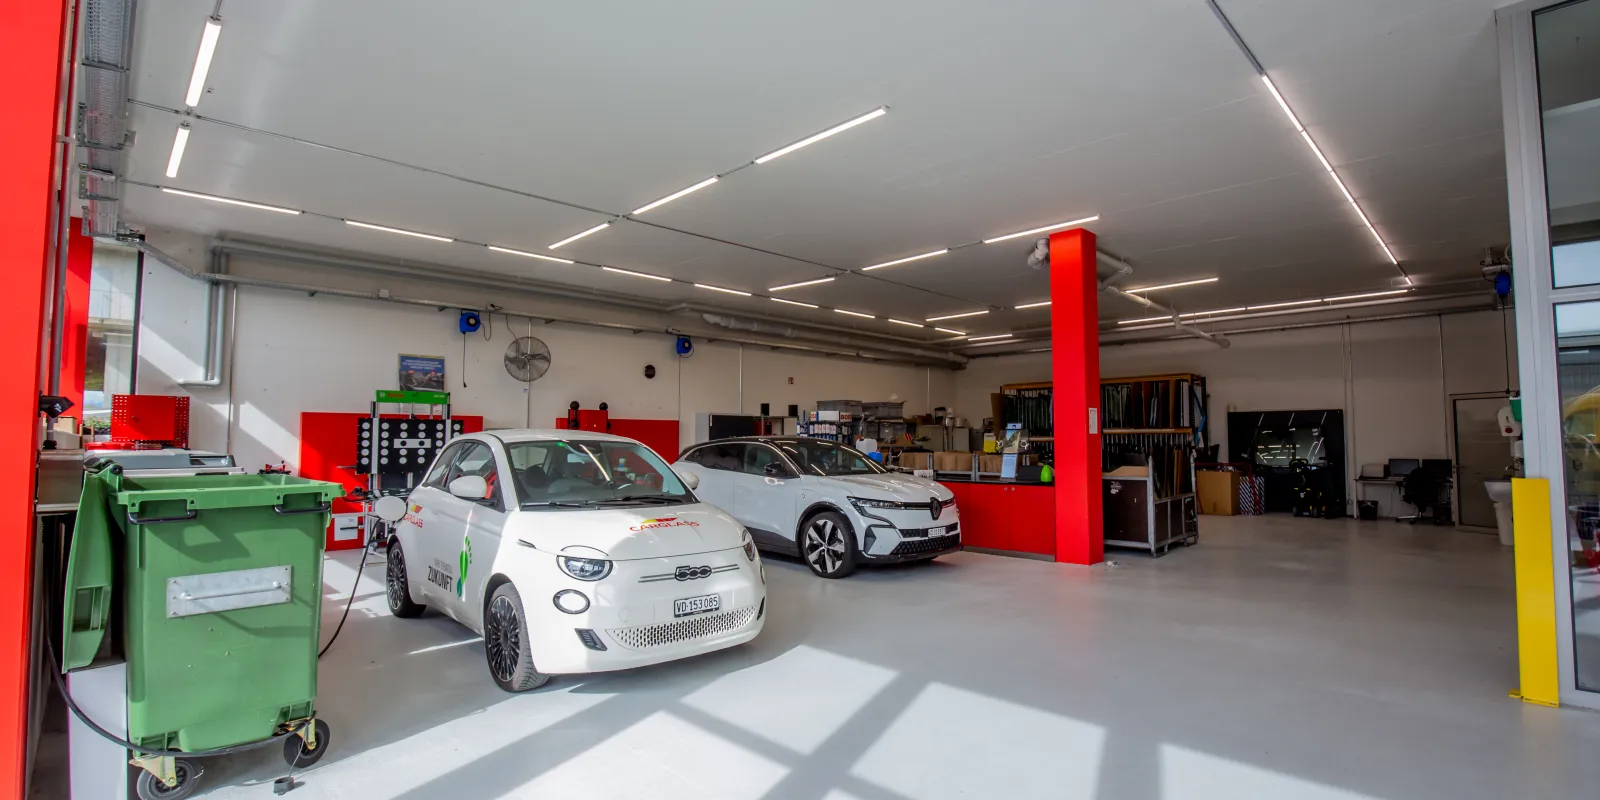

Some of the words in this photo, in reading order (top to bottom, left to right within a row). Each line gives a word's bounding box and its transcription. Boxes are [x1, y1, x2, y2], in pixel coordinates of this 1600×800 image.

[629, 521, 700, 532] CARGLASS
[427, 565, 453, 593] ZUKUNFT
[675, 565, 712, 581] 500
